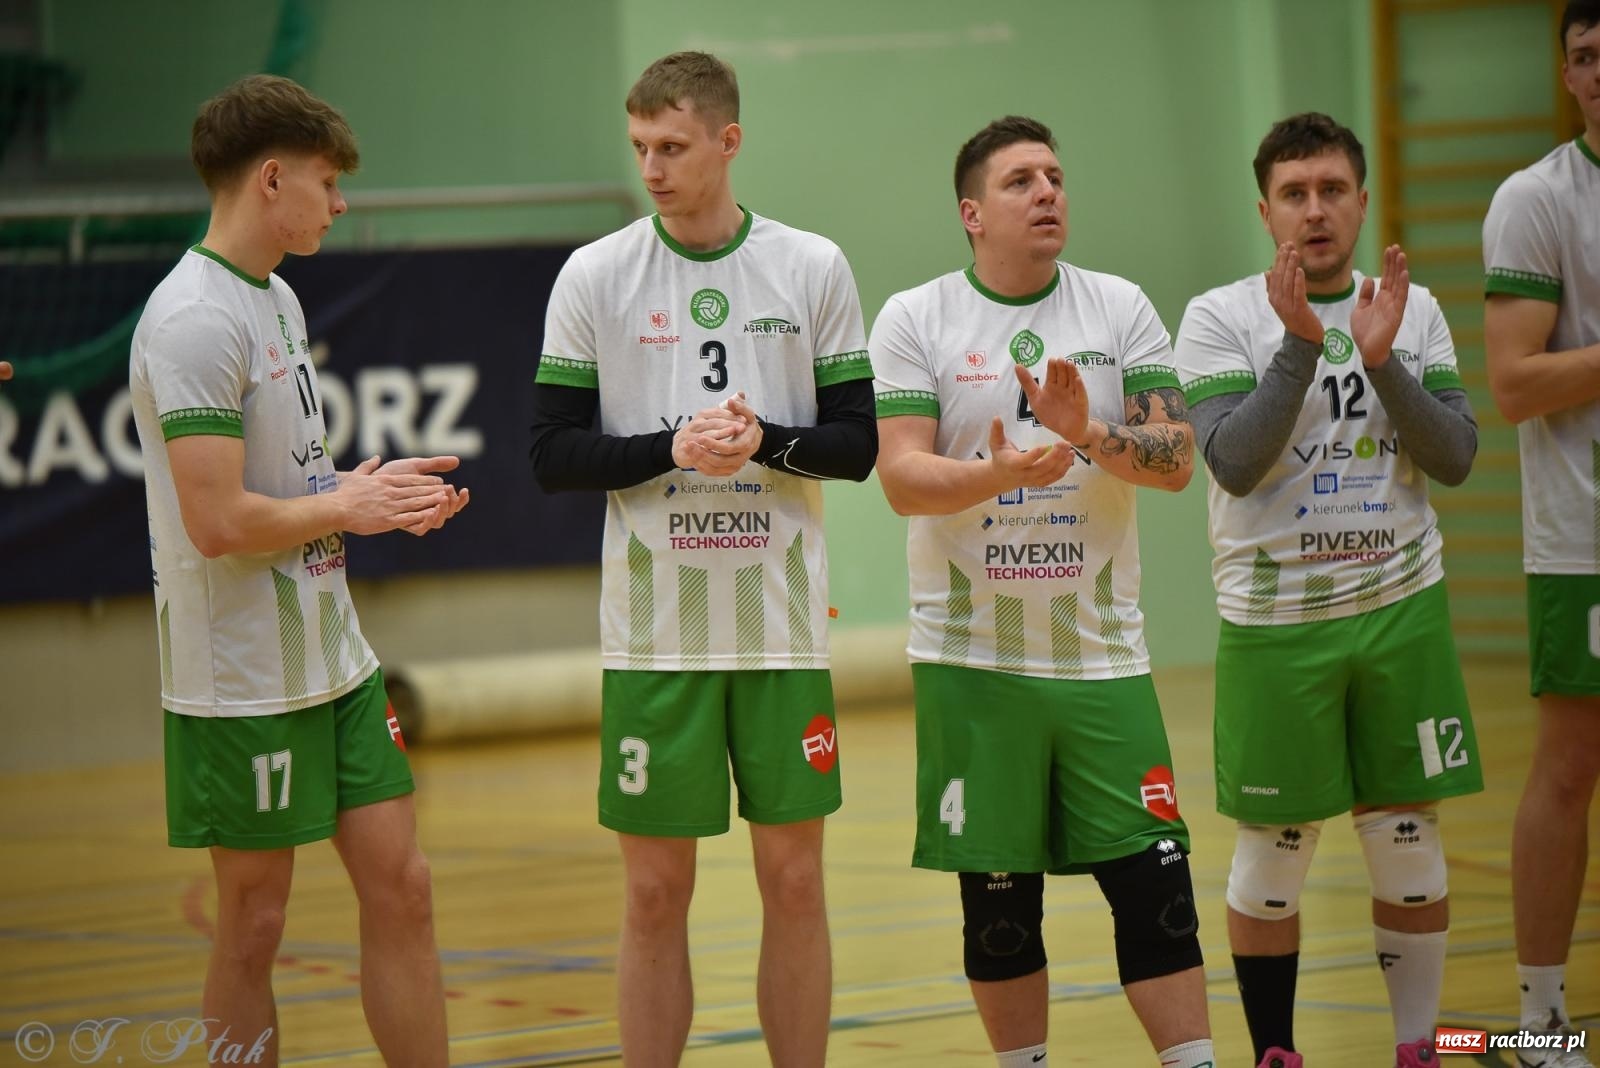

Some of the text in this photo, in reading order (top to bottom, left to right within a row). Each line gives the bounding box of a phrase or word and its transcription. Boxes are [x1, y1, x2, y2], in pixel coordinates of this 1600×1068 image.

[700, 340, 729, 393] 3
[1321, 371, 1368, 423] 12
[680, 480, 776, 495] kierunekbmp.pl
[669, 511, 770, 534] PIVEXIN
[998, 511, 1089, 527] kierunekbmp.pl
[670, 535, 770, 550] TECHNOLOGY
[1300, 528, 1395, 552] PIVEXIN
[984, 542, 1084, 564] PIVEXIN
[985, 564, 1083, 580] TECHNOLOGY
[1416, 716, 1468, 779] 12
[618, 736, 649, 796] 3
[251, 748, 292, 813] 17
[939, 778, 966, 836] 4
